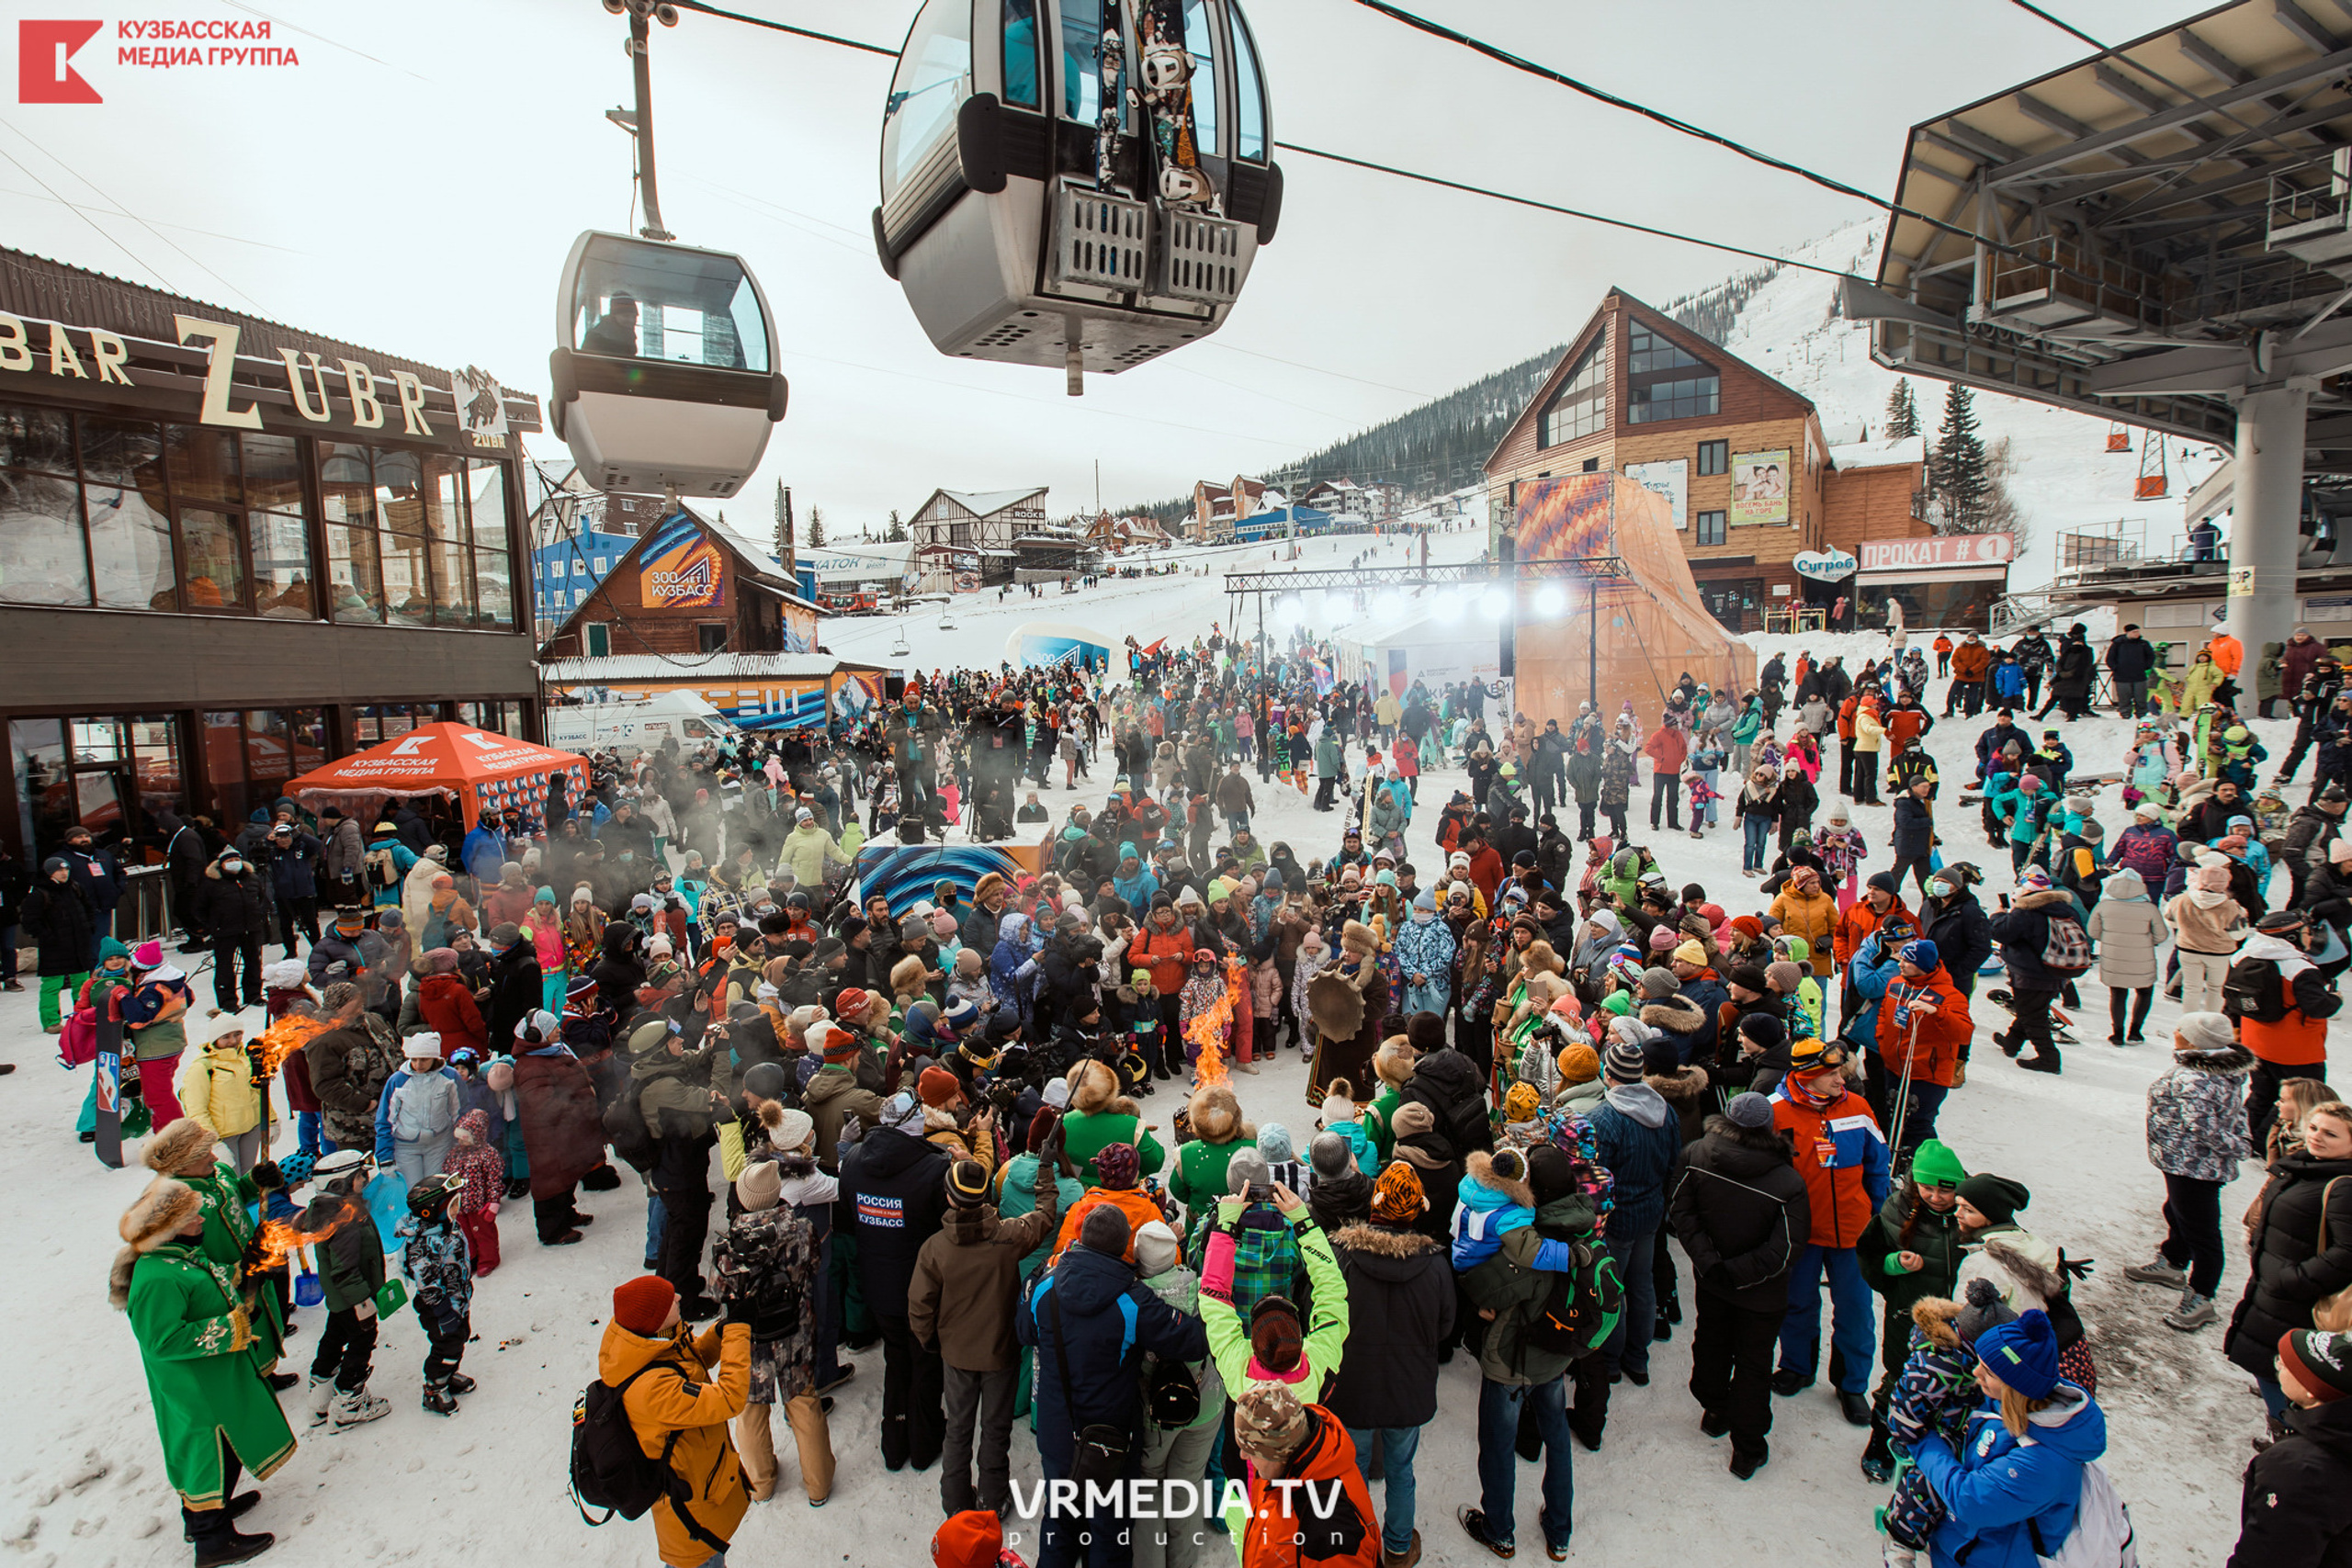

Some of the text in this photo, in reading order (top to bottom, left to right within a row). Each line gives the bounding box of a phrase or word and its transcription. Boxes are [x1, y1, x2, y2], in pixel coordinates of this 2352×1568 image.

[0, 313, 434, 436] BAR ZUBR
[471, 433, 506, 448] ZUBR
[1863, 541, 1945, 567] ПРОКАТ
[1797, 557, 1854, 573] Сугроб
[651, 571, 679, 584] 300
[651, 584, 714, 597] КУЗБАСС
[351, 758, 439, 768] КУЗБАССКАЯ
[334, 768, 387, 778] МЕДИА
[384, 766, 435, 776] ГРУППА
[857, 1193, 902, 1209] РОССИЯ
[858, 1213, 904, 1227] КУЗБАСС
